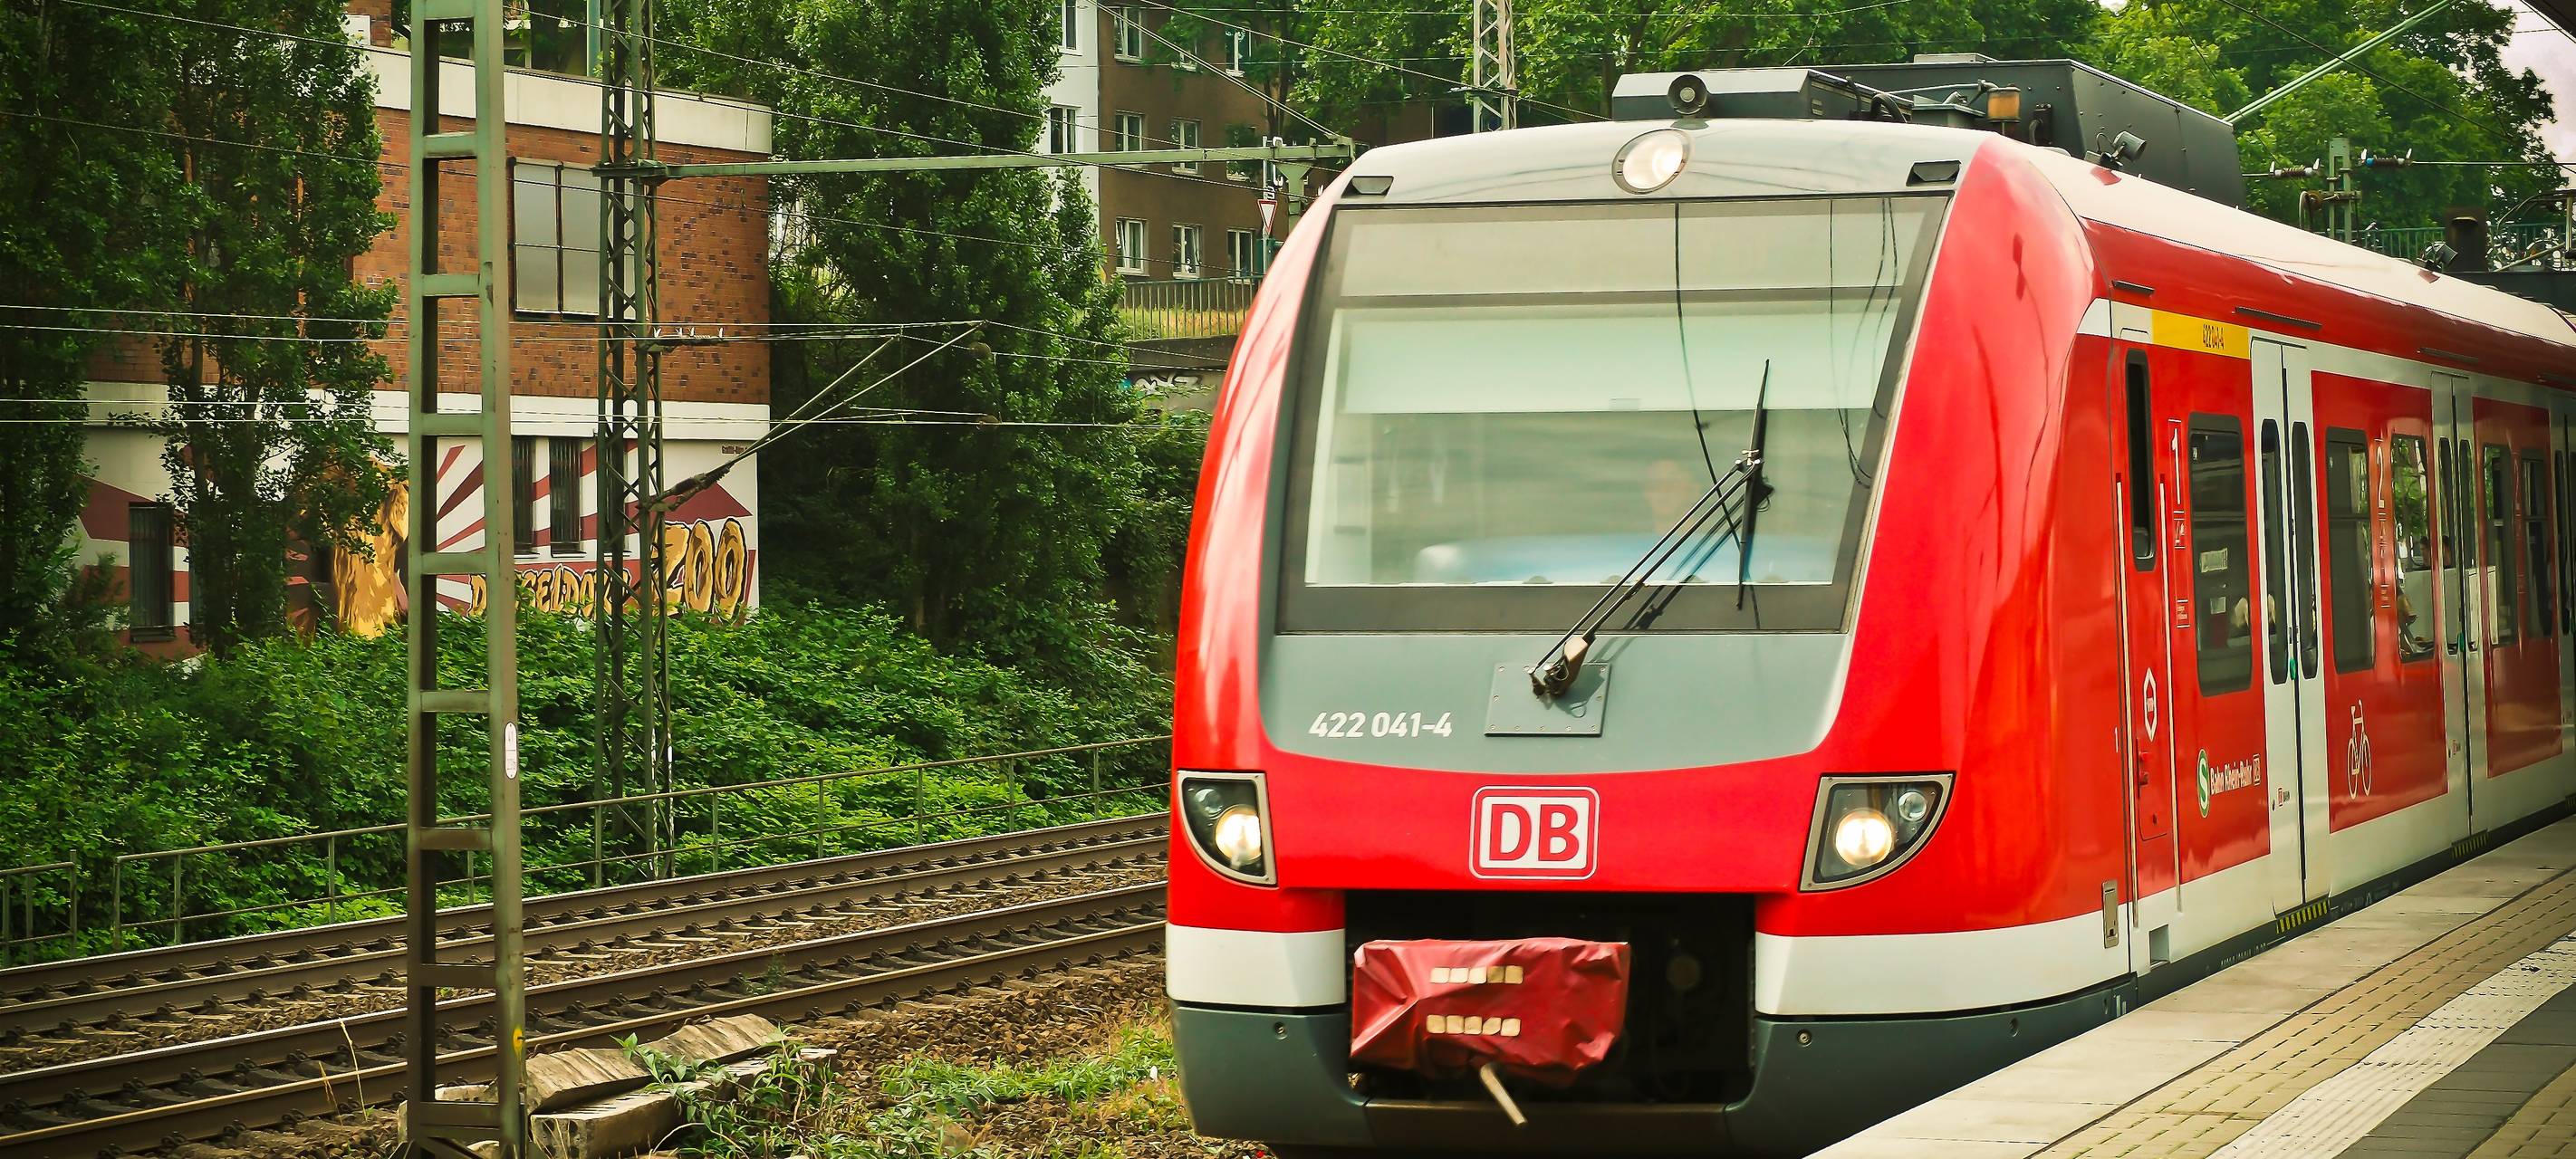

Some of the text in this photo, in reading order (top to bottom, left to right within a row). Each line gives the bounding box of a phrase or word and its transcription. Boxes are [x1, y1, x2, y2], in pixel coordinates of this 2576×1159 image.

[2376, 445, 2385, 509] 2
[649, 517, 747, 620] ZOO
[1309, 712, 1452, 738] 422 041-4
[1489, 803, 1580, 861] DB
